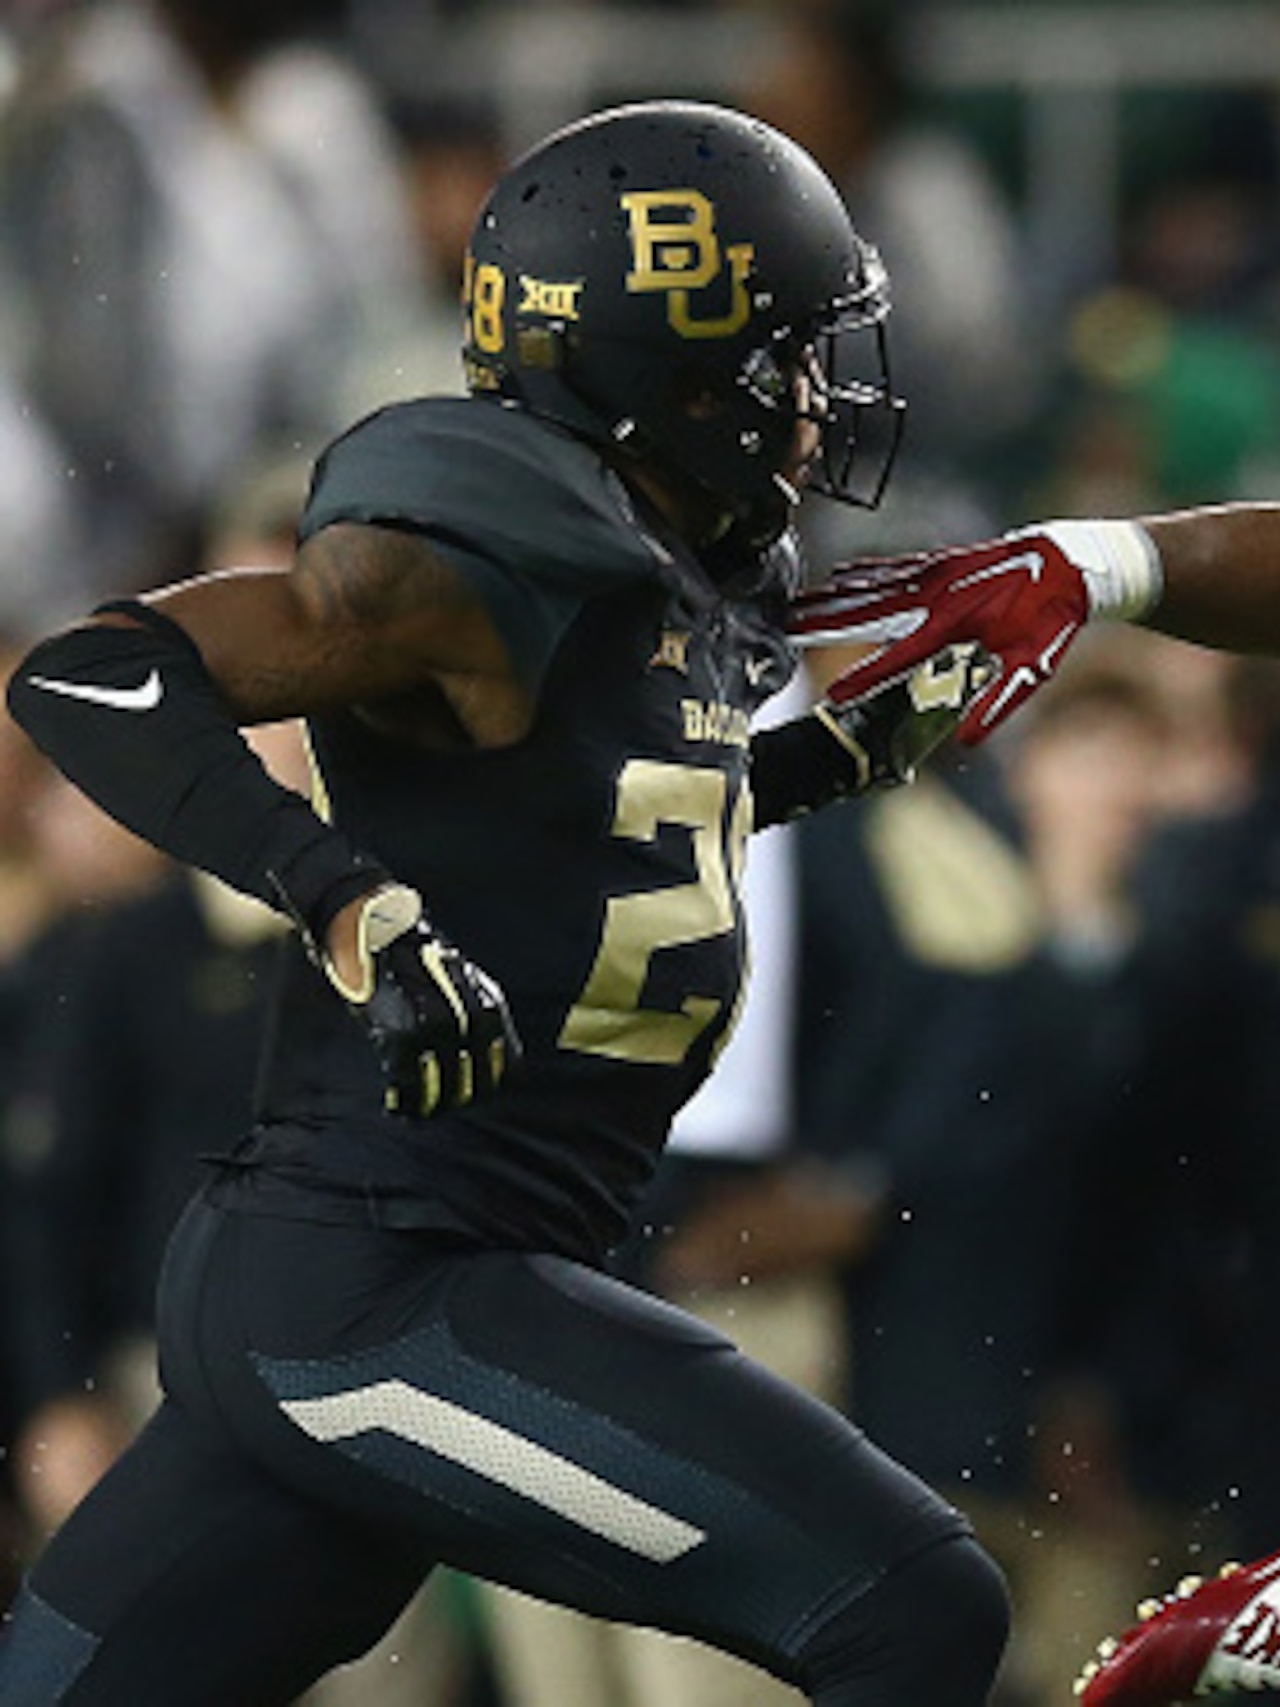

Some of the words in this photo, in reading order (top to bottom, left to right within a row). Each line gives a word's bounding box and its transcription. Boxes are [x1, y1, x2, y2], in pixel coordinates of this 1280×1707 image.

[463, 256, 506, 353] 8
[620, 189, 754, 339] BU
[556, 758, 755, 1066] 2
